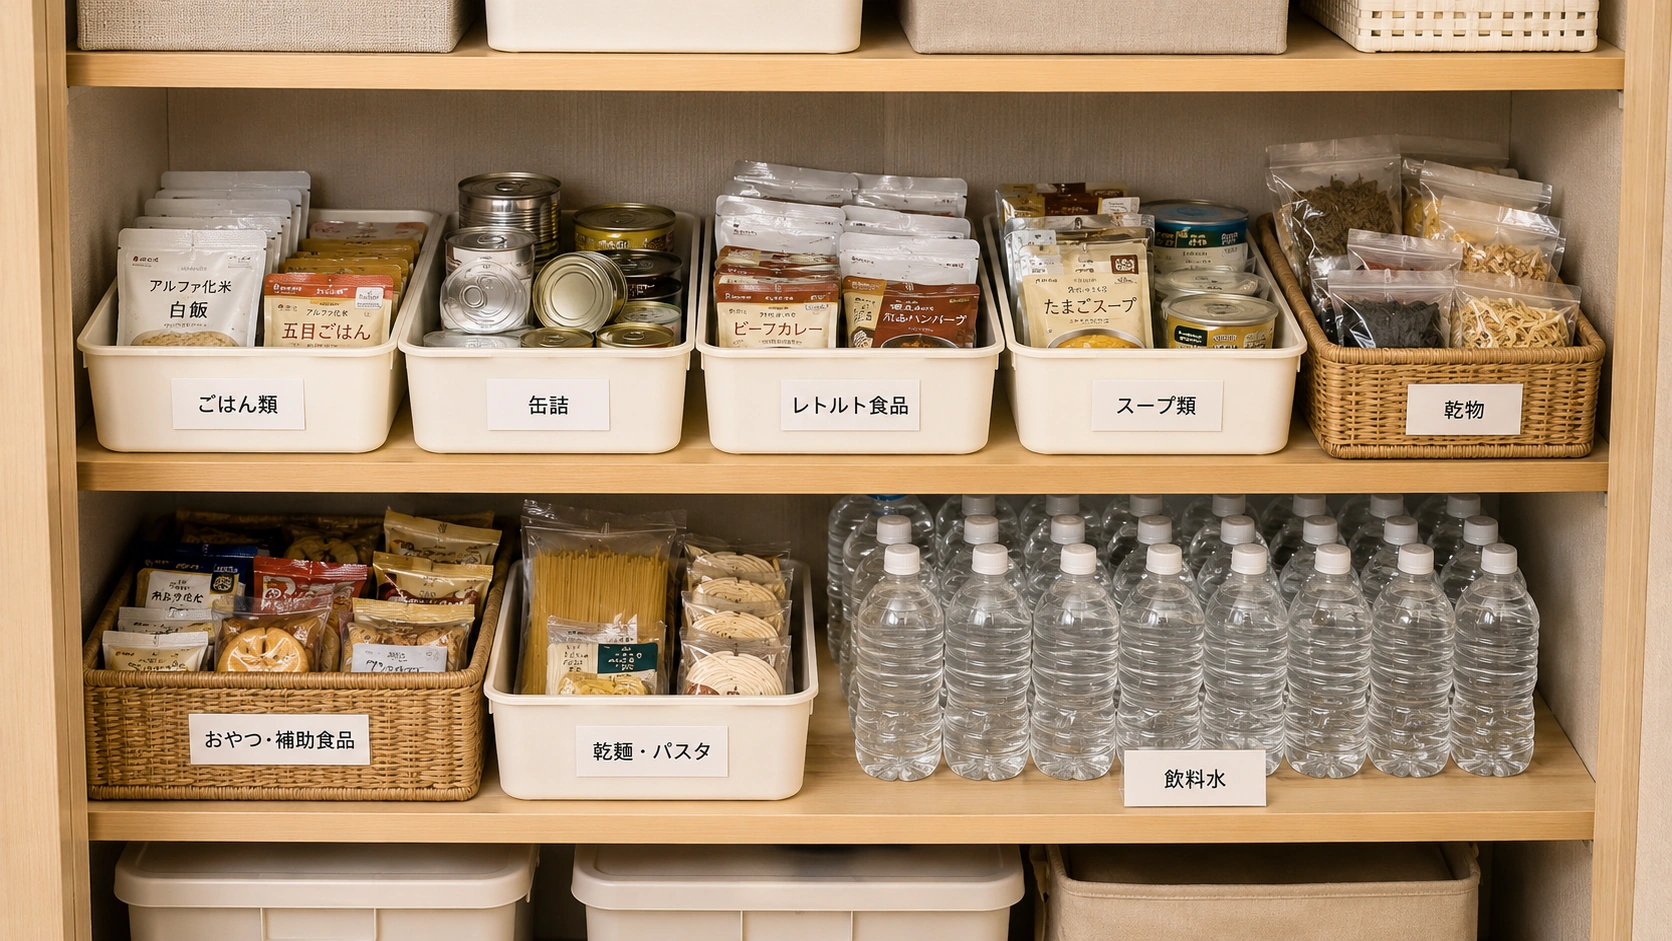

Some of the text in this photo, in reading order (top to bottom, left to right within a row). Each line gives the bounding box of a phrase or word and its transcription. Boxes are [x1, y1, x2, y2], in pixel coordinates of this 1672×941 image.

[149, 279, 232, 294] アルファ化米
[169, 300, 208, 319] 白飯
[1043, 296, 1138, 315] たまごスープ
[281, 322, 371, 340] 五目ごはん
[734, 320, 823, 336] ビーフカレー
[198, 393, 279, 415] ごはん類
[528, 394, 570, 416] 缶詰
[793, 395, 909, 416] レトルト食品
[1116, 394, 1197, 416] スープ類
[1443, 399, 1485, 420] 乾物
[204, 729, 355, 750] おやつ・補助食品
[592, 741, 711, 762] 乾麺・パスタ
[1164, 768, 1227, 790] 飲料水
